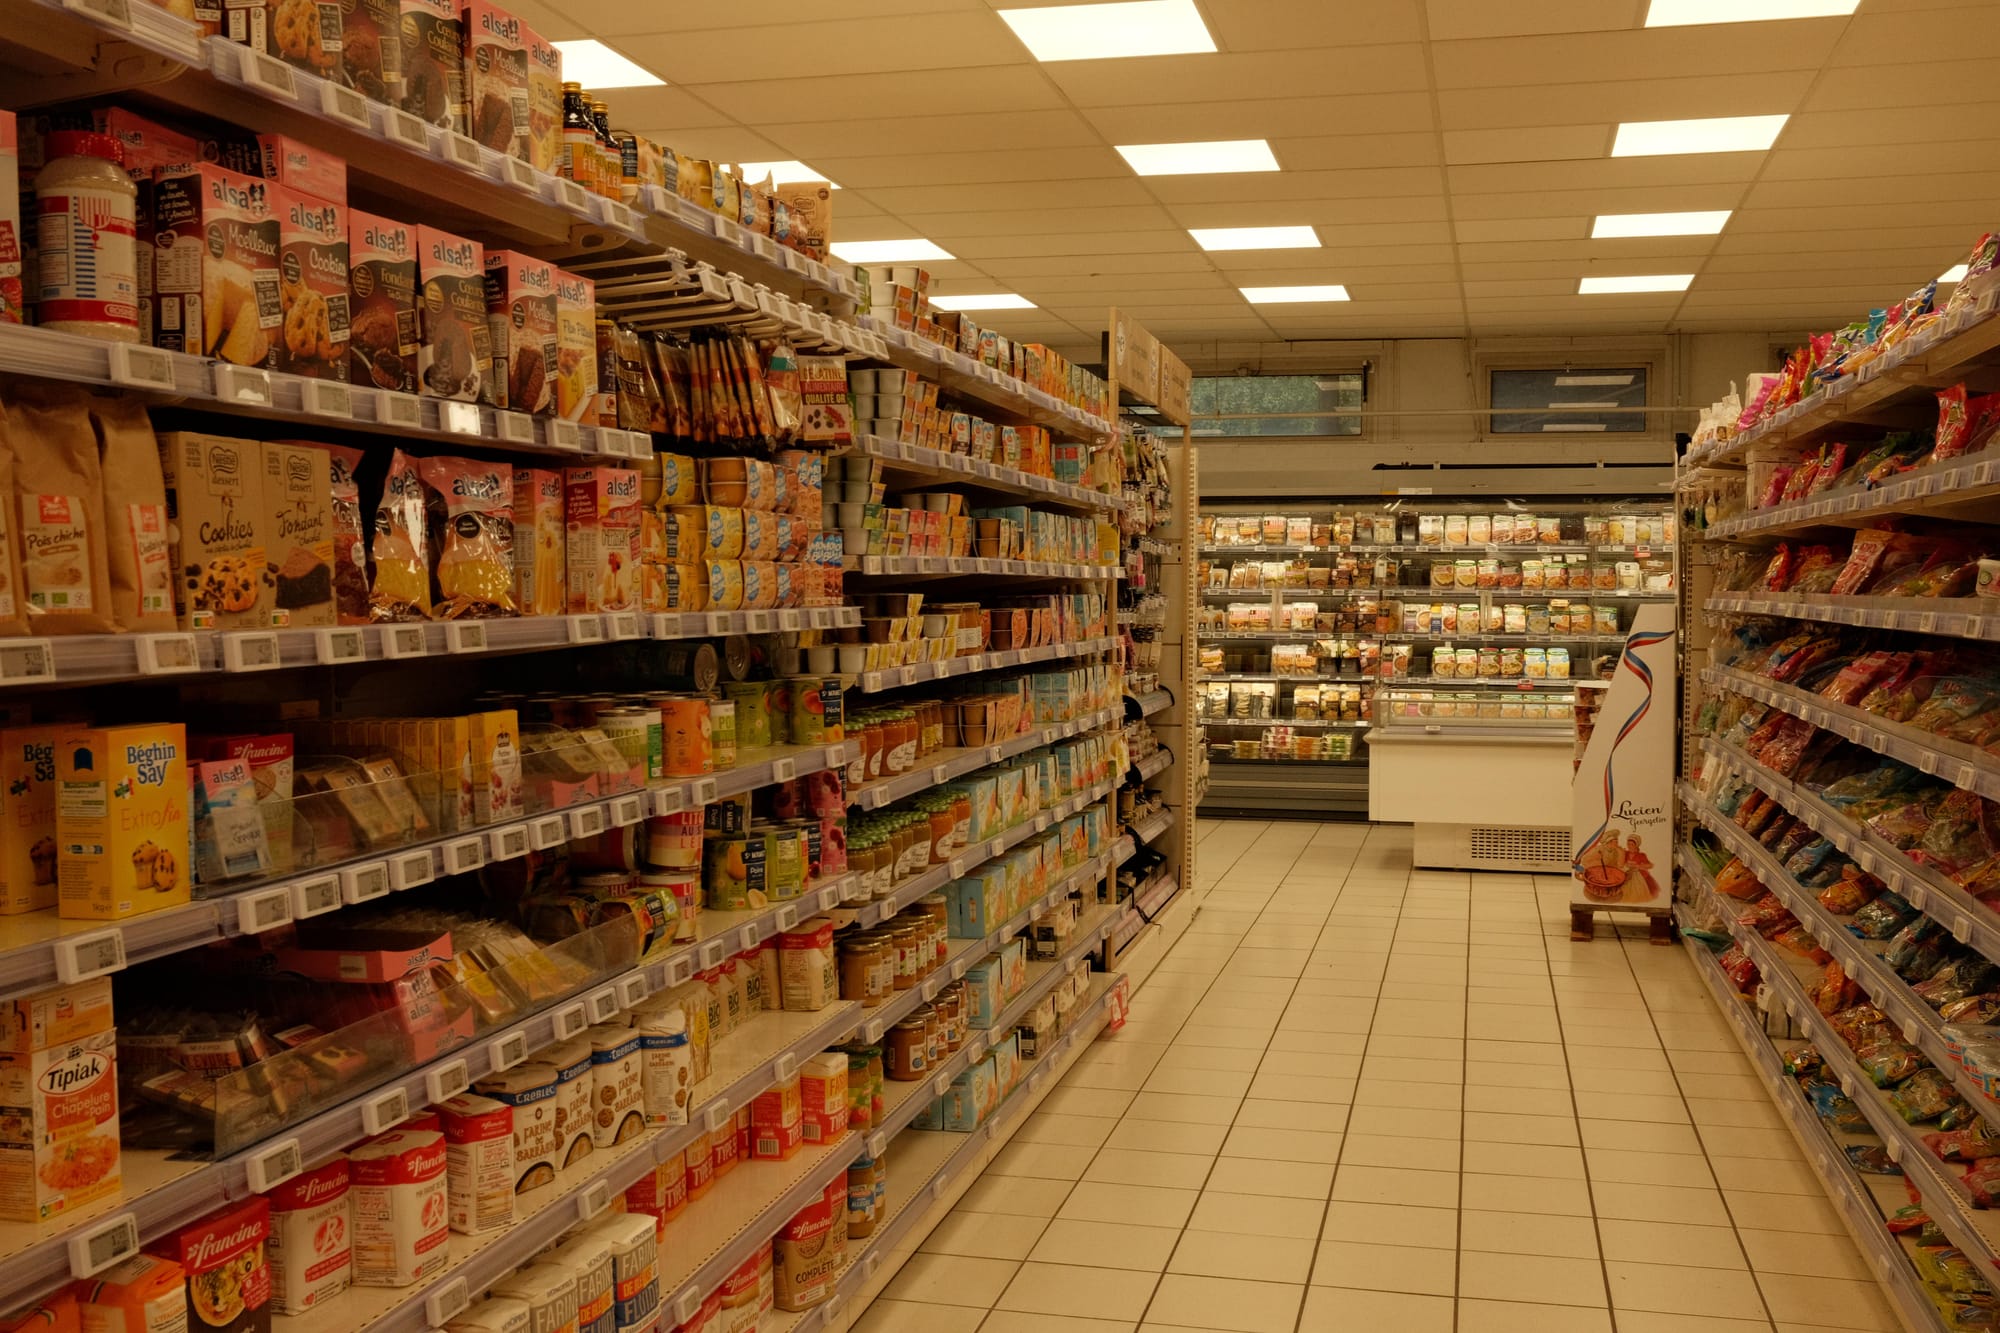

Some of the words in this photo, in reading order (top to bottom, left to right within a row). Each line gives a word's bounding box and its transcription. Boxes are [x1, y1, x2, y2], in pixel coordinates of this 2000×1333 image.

[482, 12, 509, 39] alsa
[212, 178, 250, 210] alsa
[290, 202, 324, 233] alsa
[228, 224, 277, 256] Moelleux
[365, 226, 396, 252] alsa
[309, 247, 346, 277] Cookies
[433, 239, 463, 267] alsa
[519, 265, 543, 289] alsa
[557, 280, 579, 302] alsa
[805, 392, 834, 404] QUALITÉ
[607, 476, 630, 496] alsa
[199, 510, 254, 545] Cookies
[276, 506, 326, 538] Fondant
[26, 533, 52, 550] Pois
[53, 528, 85, 544] chiche
[127, 741, 176, 767] Béghin
[242, 743, 287, 763] francine
[137, 761, 168, 787] Say
[212, 769, 237, 784] alsa
[1611, 800, 1664, 820] Lucien
[746, 975, 761, 997] BIO
[708, 1002, 721, 1024] BIO
[728, 990, 739, 1012] BIO
[47, 1058, 101, 1092] Tipiak
[52, 1091, 110, 1119] Chapelure
[524, 1120, 552, 1143] FARINE
[194, 1221, 262, 1269] francine
[622, 1238, 657, 1280] FARINE
